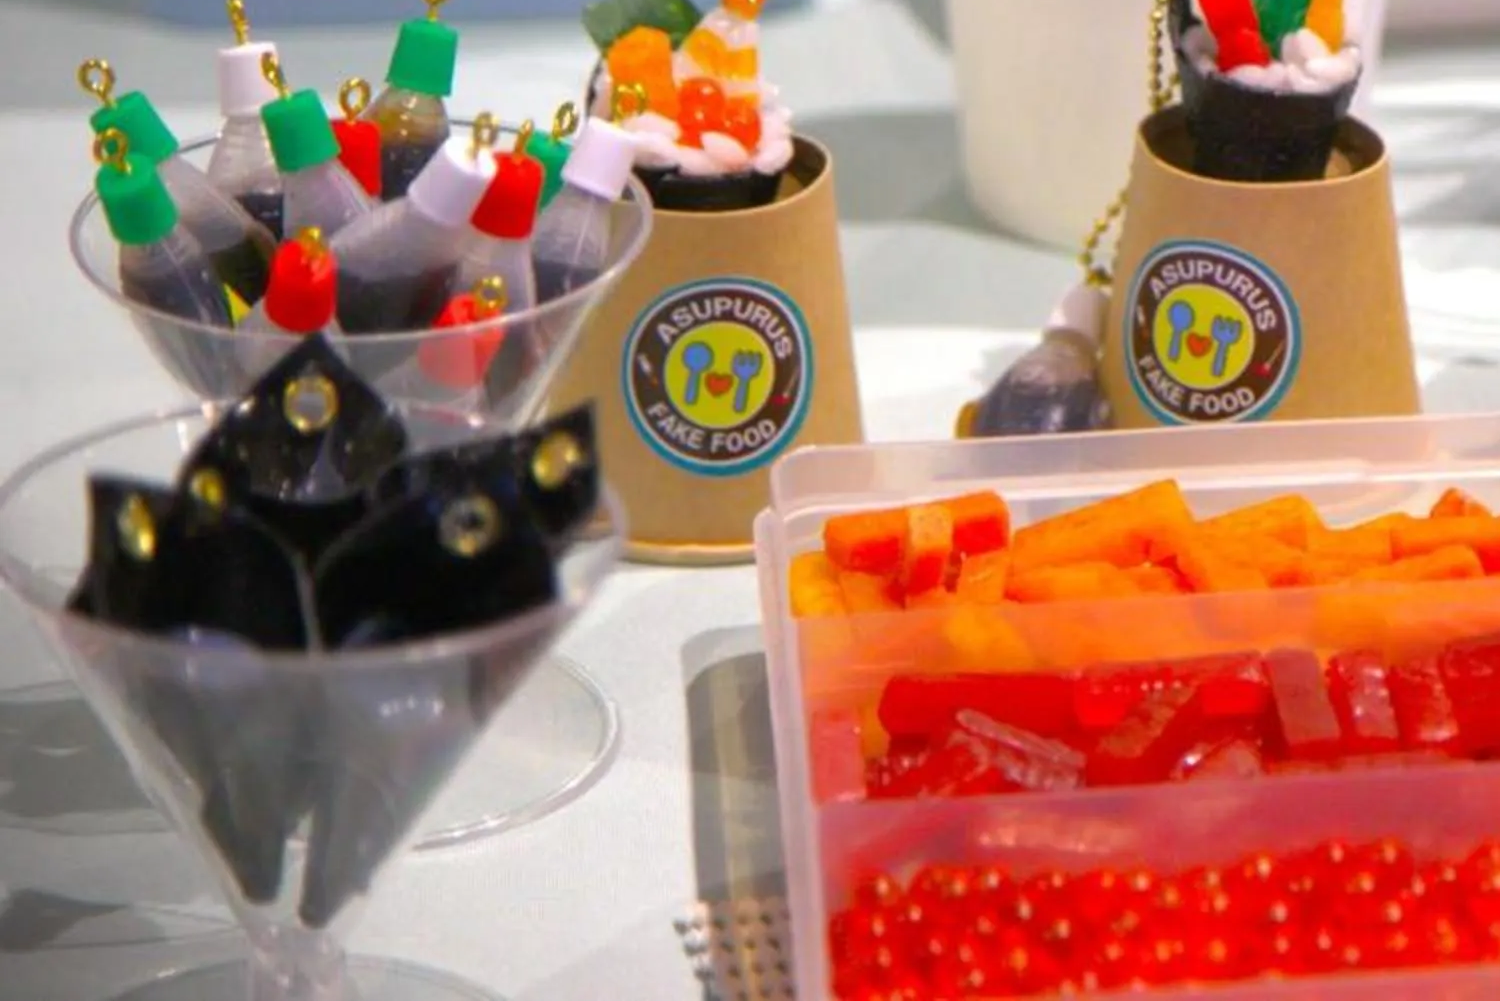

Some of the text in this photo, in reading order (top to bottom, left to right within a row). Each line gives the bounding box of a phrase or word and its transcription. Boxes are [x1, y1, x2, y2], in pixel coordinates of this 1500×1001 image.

[1149, 259, 1277, 331] ASUPURUS
[656, 296, 792, 359] ASUPURUS
[1139, 355, 1256, 415] FAKE FOOD
[648, 402, 777, 454] FAKE FOOD
